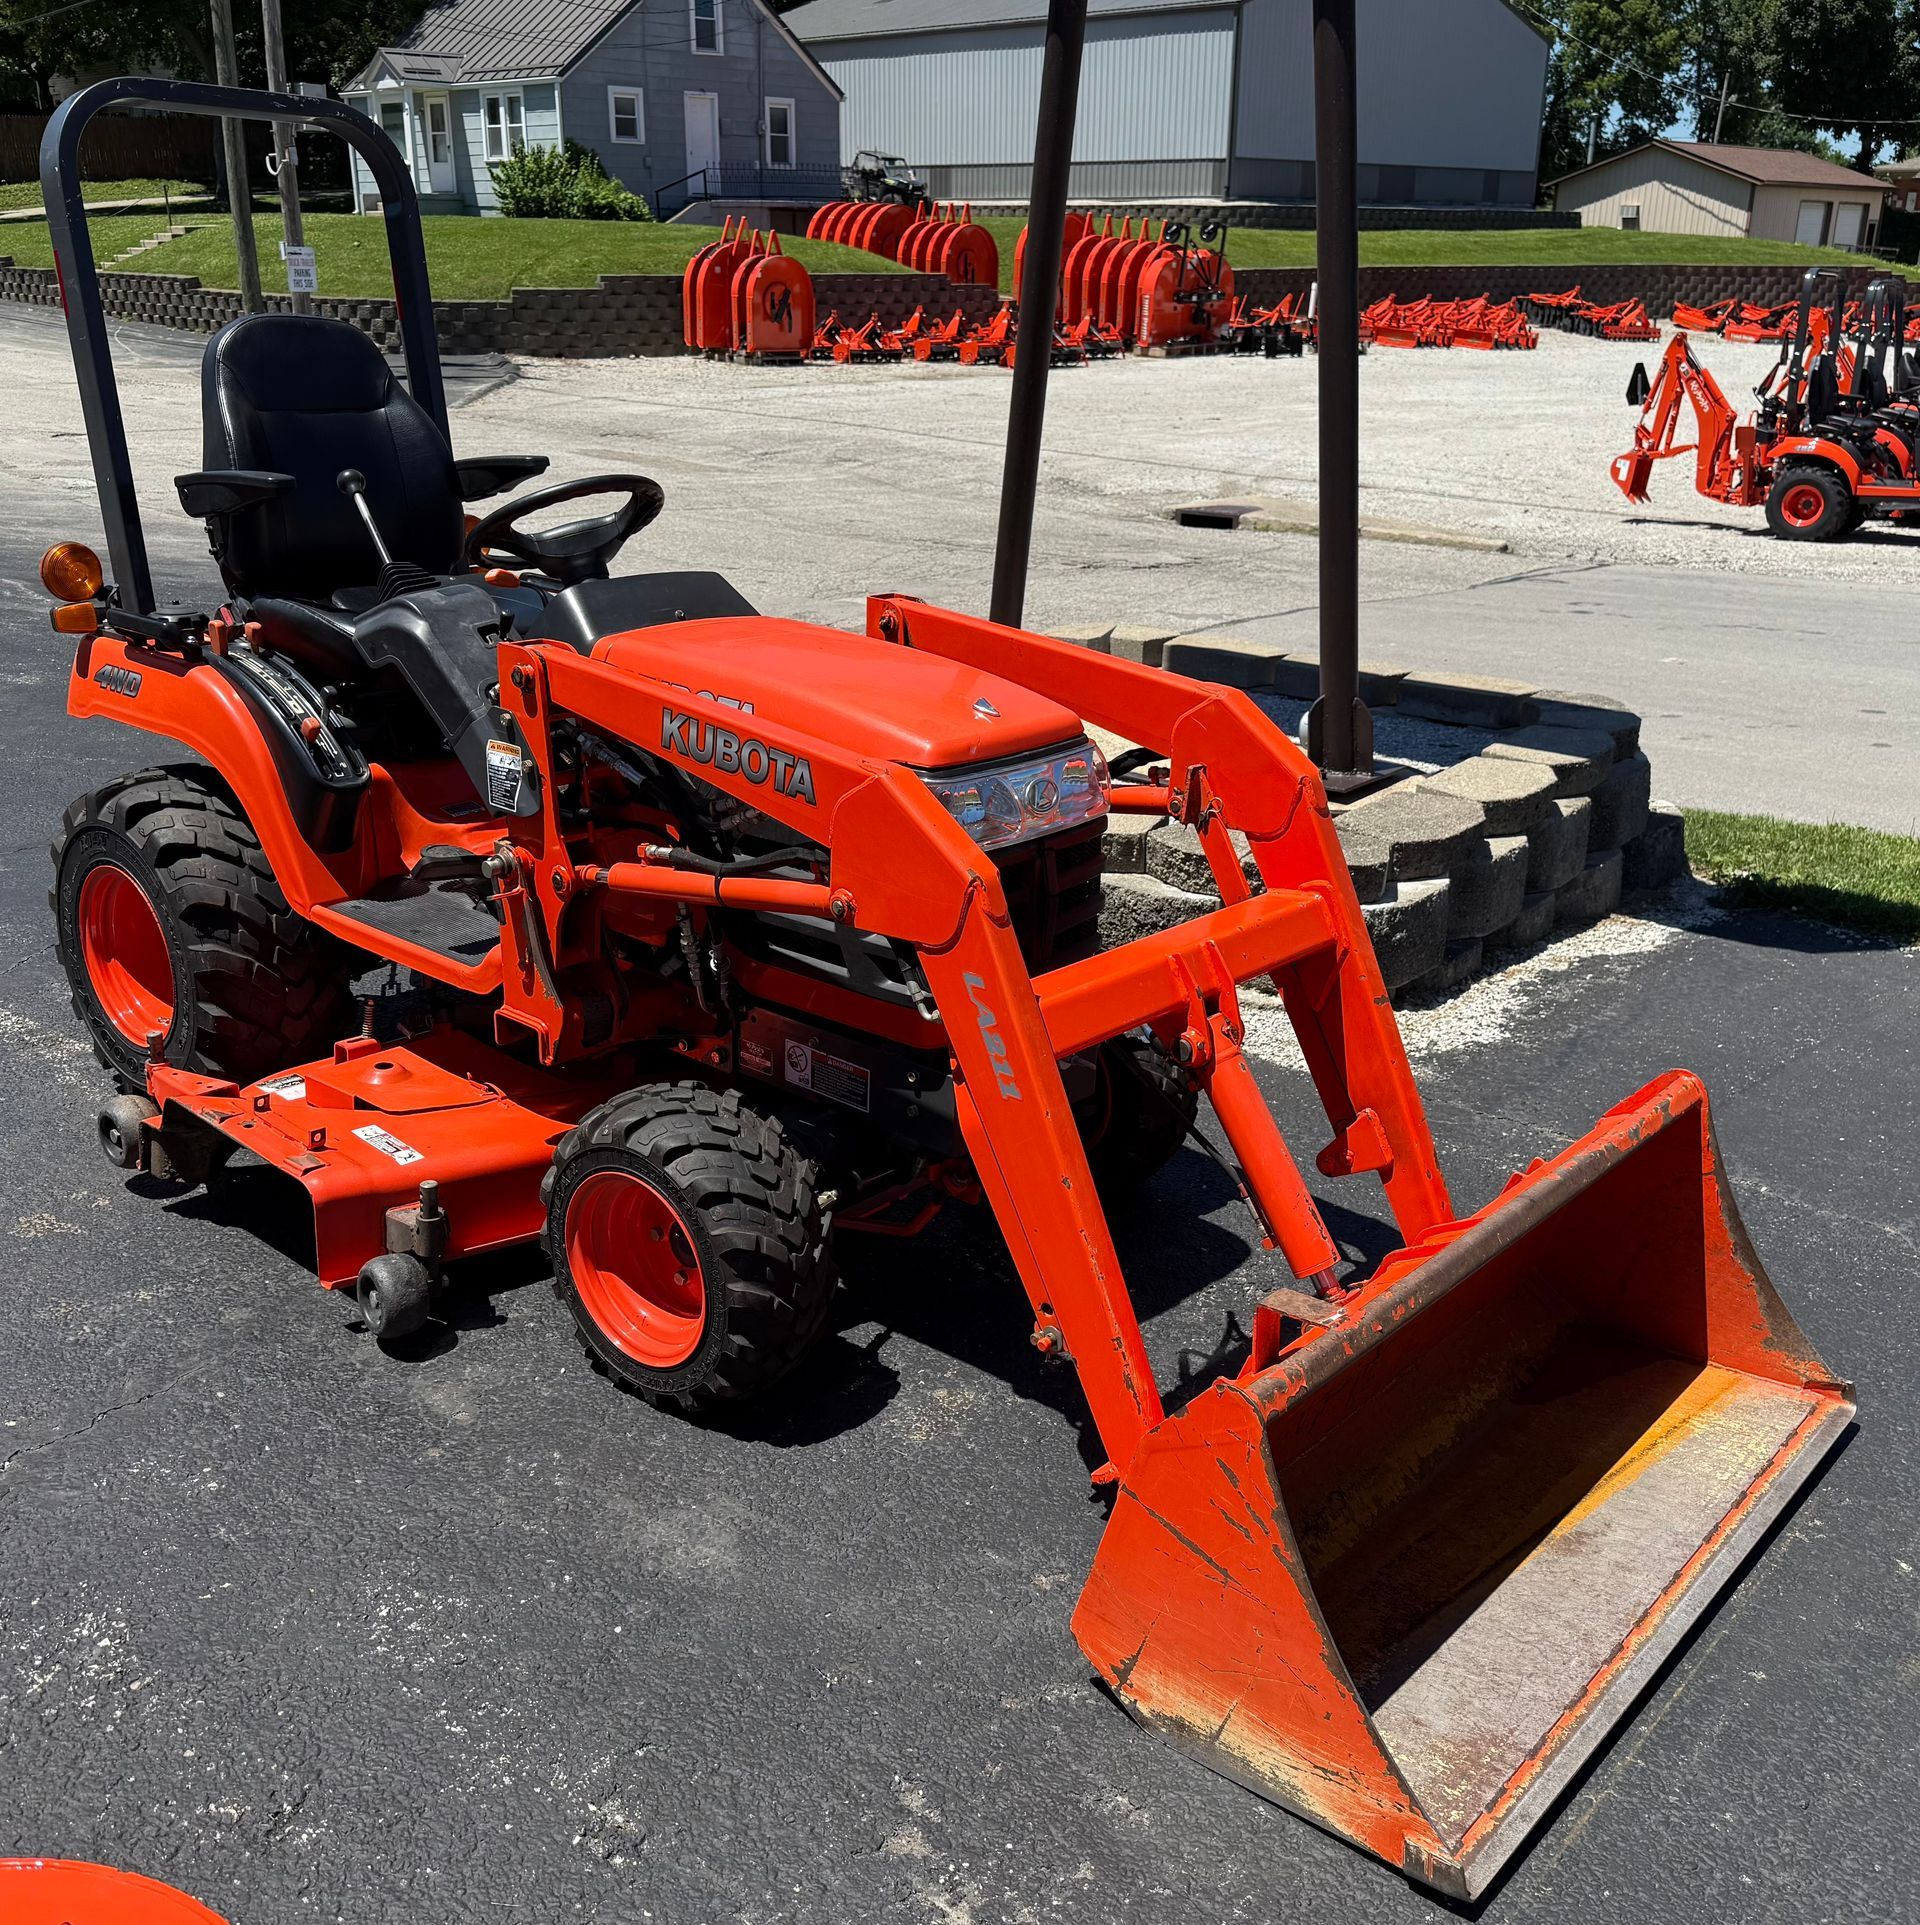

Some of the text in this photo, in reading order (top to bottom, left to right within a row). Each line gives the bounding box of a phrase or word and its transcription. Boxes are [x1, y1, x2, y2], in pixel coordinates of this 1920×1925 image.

[294, 269, 311, 277] PARKING
[293, 279, 314, 287] THIS SIDE
[94, 664, 143, 698] 4WD
[497, 744, 519, 755] WARNING
[661, 707, 817, 806] KUBOTA
[962, 972, 1023, 1100] LA211
[832, 1060, 854, 1073] DANGER
